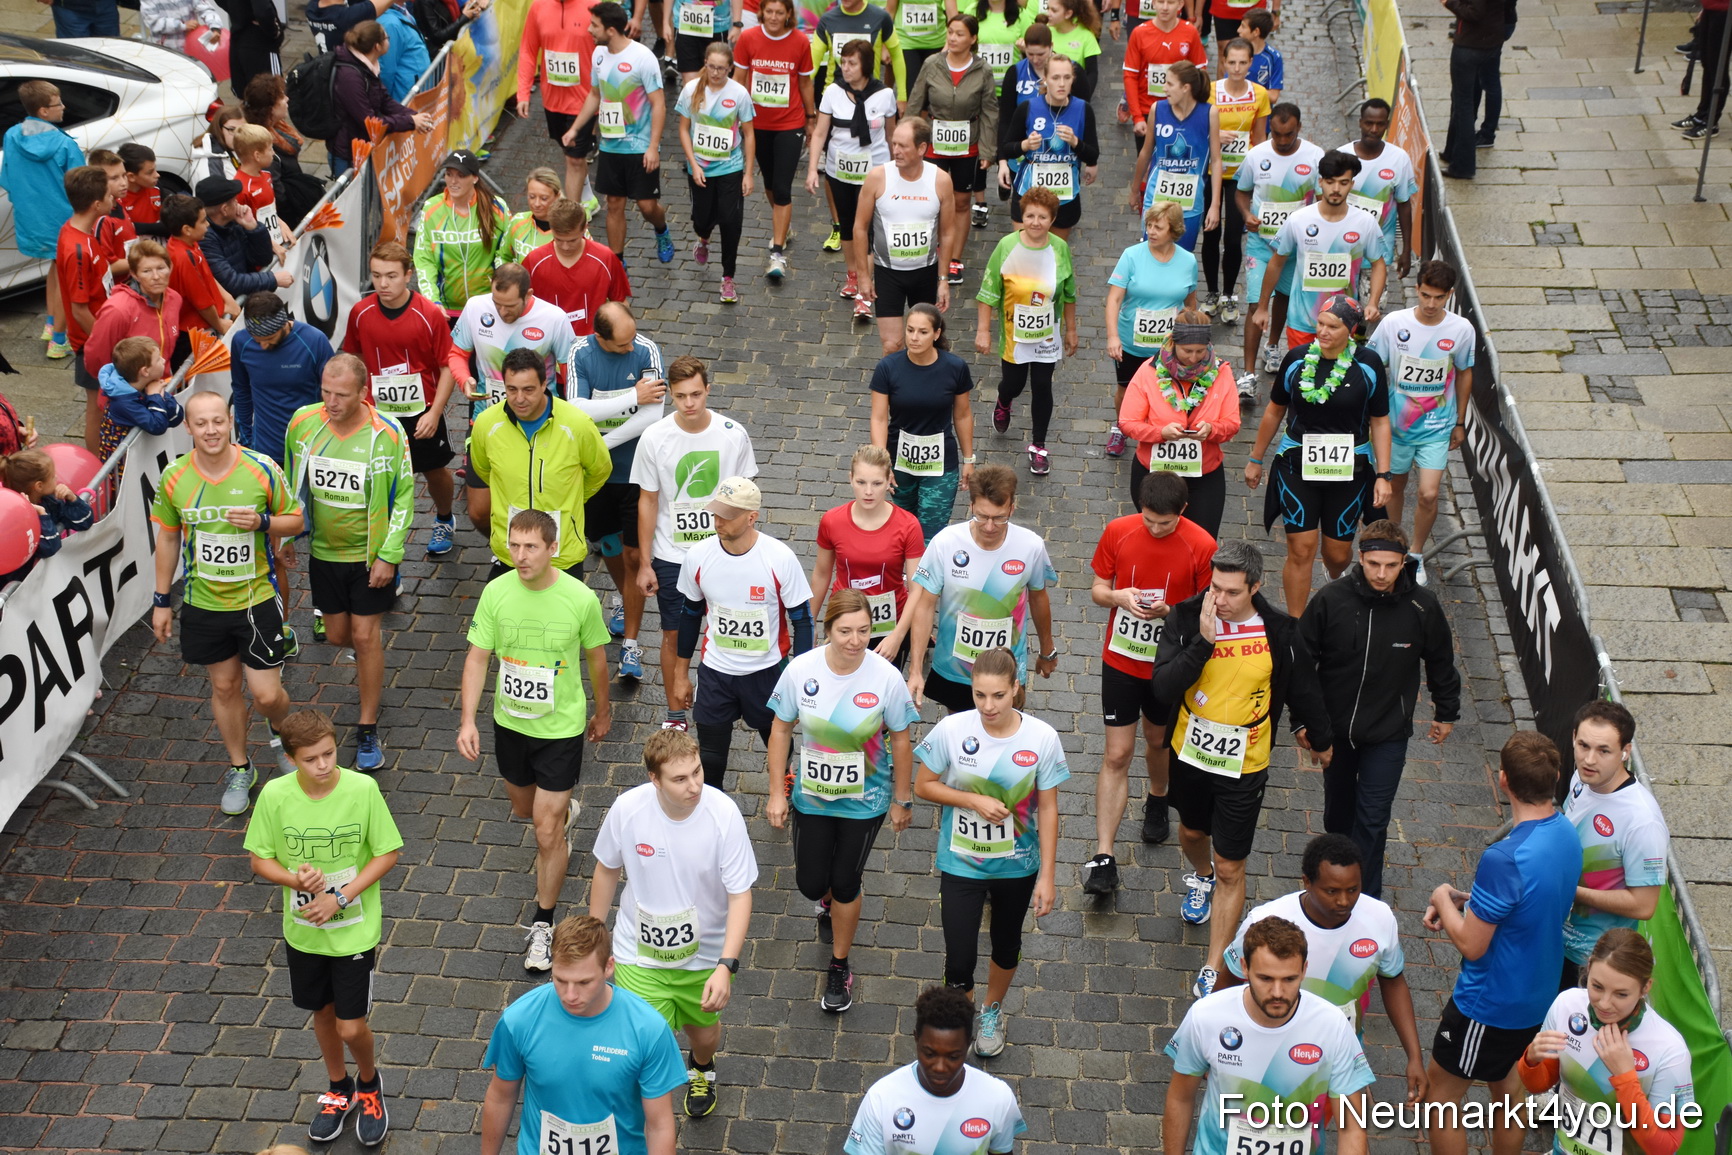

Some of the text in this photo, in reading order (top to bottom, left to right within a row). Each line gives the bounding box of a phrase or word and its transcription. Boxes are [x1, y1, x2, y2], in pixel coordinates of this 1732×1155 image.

[683, 11, 710, 25] 5064
[906, 12, 934, 23] 5144
[548, 59, 576, 74] 5116
[752, 59, 789, 69] NEUMARKT
[756, 80, 786, 94] 5047
[1033, 117, 1046, 131] 8
[1155, 123, 1173, 138] 10
[697, 133, 729, 150] 5105
[936, 129, 967, 142] 5006
[838, 159, 869, 173] 5077
[1037, 172, 1069, 186] 5028
[1160, 180, 1193, 197] 5138
[1262, 212, 1292, 226] 523
[893, 231, 928, 247] 5015
[1309, 263, 1347, 278] 5302
[1017, 312, 1051, 329] 5251
[1139, 317, 1173, 334] 5224
[1024, 331, 1045, 339] Christa
[1403, 365, 1444, 383] 2734
[378, 385, 419, 402] 5072
[388, 404, 411, 412] Patrick
[902, 442, 940, 461] 5033
[1157, 442, 1198, 460] 5048
[1308, 446, 1350, 463] 5147
[905, 461, 933, 471] Christian
[1164, 463, 1188, 472] Monika
[1314, 467, 1343, 475] Susanne
[315, 469, 360, 491] 5276
[324, 491, 350, 502] Roman
[676, 511, 715, 530] 530
[202, 543, 250, 564] 5269
[216, 567, 235, 576] Jens
[951, 568, 969, 576] PARTL
[1004, 562, 1023, 572] Hervis
[718, 617, 764, 638] 5243
[1118, 615, 1161, 644] 5136
[733, 640, 748, 648] Tilo
[961, 626, 1007, 648] 5076
[1127, 642, 1147, 655] Josef
[1211, 645, 1235, 660] AX
[504, 674, 548, 700] 5325
[510, 699, 533, 713] Thomas
[801, 696, 817, 706] PARTL
[855, 694, 877, 705] Hervis
[1191, 726, 1240, 757] 5242
[958, 755, 978, 765] PARTL
[1015, 754, 1035, 763] Hervis
[1196, 751, 1227, 767] Gerhard
[807, 760, 859, 784] 5075
[816, 784, 847, 795] Claudia
[958, 814, 1006, 841] 5111
[1595, 816, 1613, 834] Hervis
[971, 843, 992, 852] Jana
[641, 922, 694, 947] 5323
[1353, 944, 1375, 955] Hervis
[591, 1053, 611, 1062] Tobias
[599, 1046, 628, 1057] PFLEIDERER
[1217, 1052, 1242, 1062] PARTL
[1293, 1046, 1320, 1059] Hervis
[1217, 1058, 1243, 1068] Neumarkt
[964, 1123, 988, 1133] Hervis
[548, 1129, 611, 1155] 5112
[892, 1133, 916, 1141] PARTL
